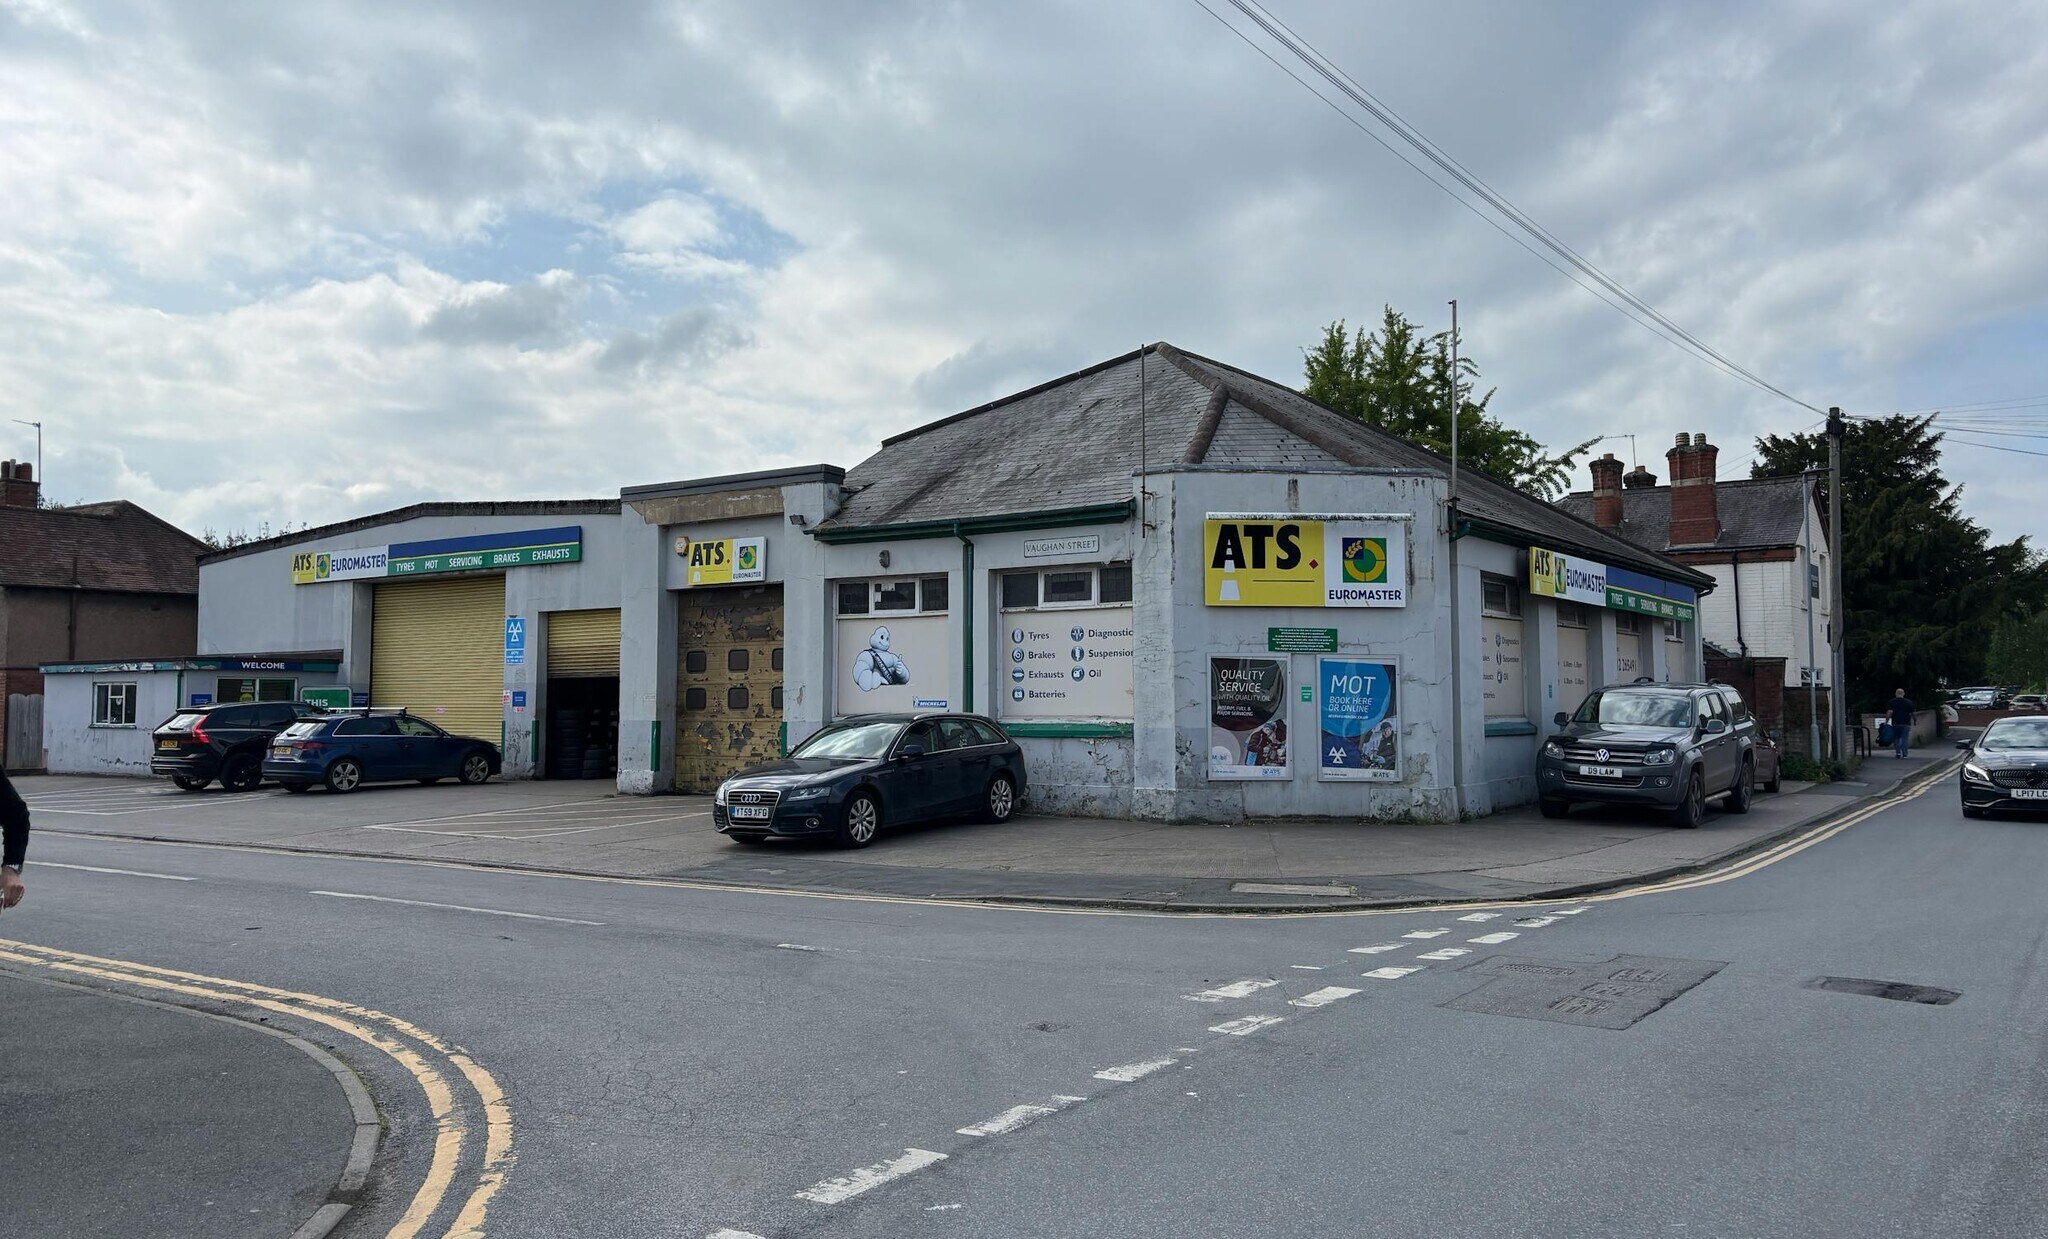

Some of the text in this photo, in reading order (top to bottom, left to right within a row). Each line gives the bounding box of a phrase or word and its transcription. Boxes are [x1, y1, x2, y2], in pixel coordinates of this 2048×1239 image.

[1026, 539, 1097, 553] VAUGHAN STREET
[331, 553, 387, 572] EUROMASTER
[396, 548, 570, 572] TYRES MOT SERVICING BRAKES EXHAUSTS
[733, 571, 762, 580] EUROMASTER
[1566, 568, 1606, 594] EUROMASTER
[1328, 589, 1402, 601] EUROMASTER
[1611, 592, 1623, 605] TYRES
[1028, 632, 1050, 641] Tyres
[1088, 628, 1133, 639] Diagnostic
[1028, 651, 1056, 660] Brakes
[241, 661, 286, 670] WELCOME
[1028, 670, 1065, 679] Exhausts
[1088, 669, 1102, 678] Oil
[1221, 669, 1265, 681] QUALITY
[1219, 681, 1262, 693] SERVICE
[1330, 674, 1376, 695] MOT
[1028, 690, 1066, 699] Batteries
[1218, 693, 1235, 701] WITH
[1235, 694, 1260, 702] QUALITY
[304, 699, 329, 708] THIS
[1329, 695, 1372, 706] BOOK HERE
[1328, 703, 1369, 713] OR ONLINE
[2016, 790, 2048, 798] LP17 LC
[753, 808, 768, 817] XFG
